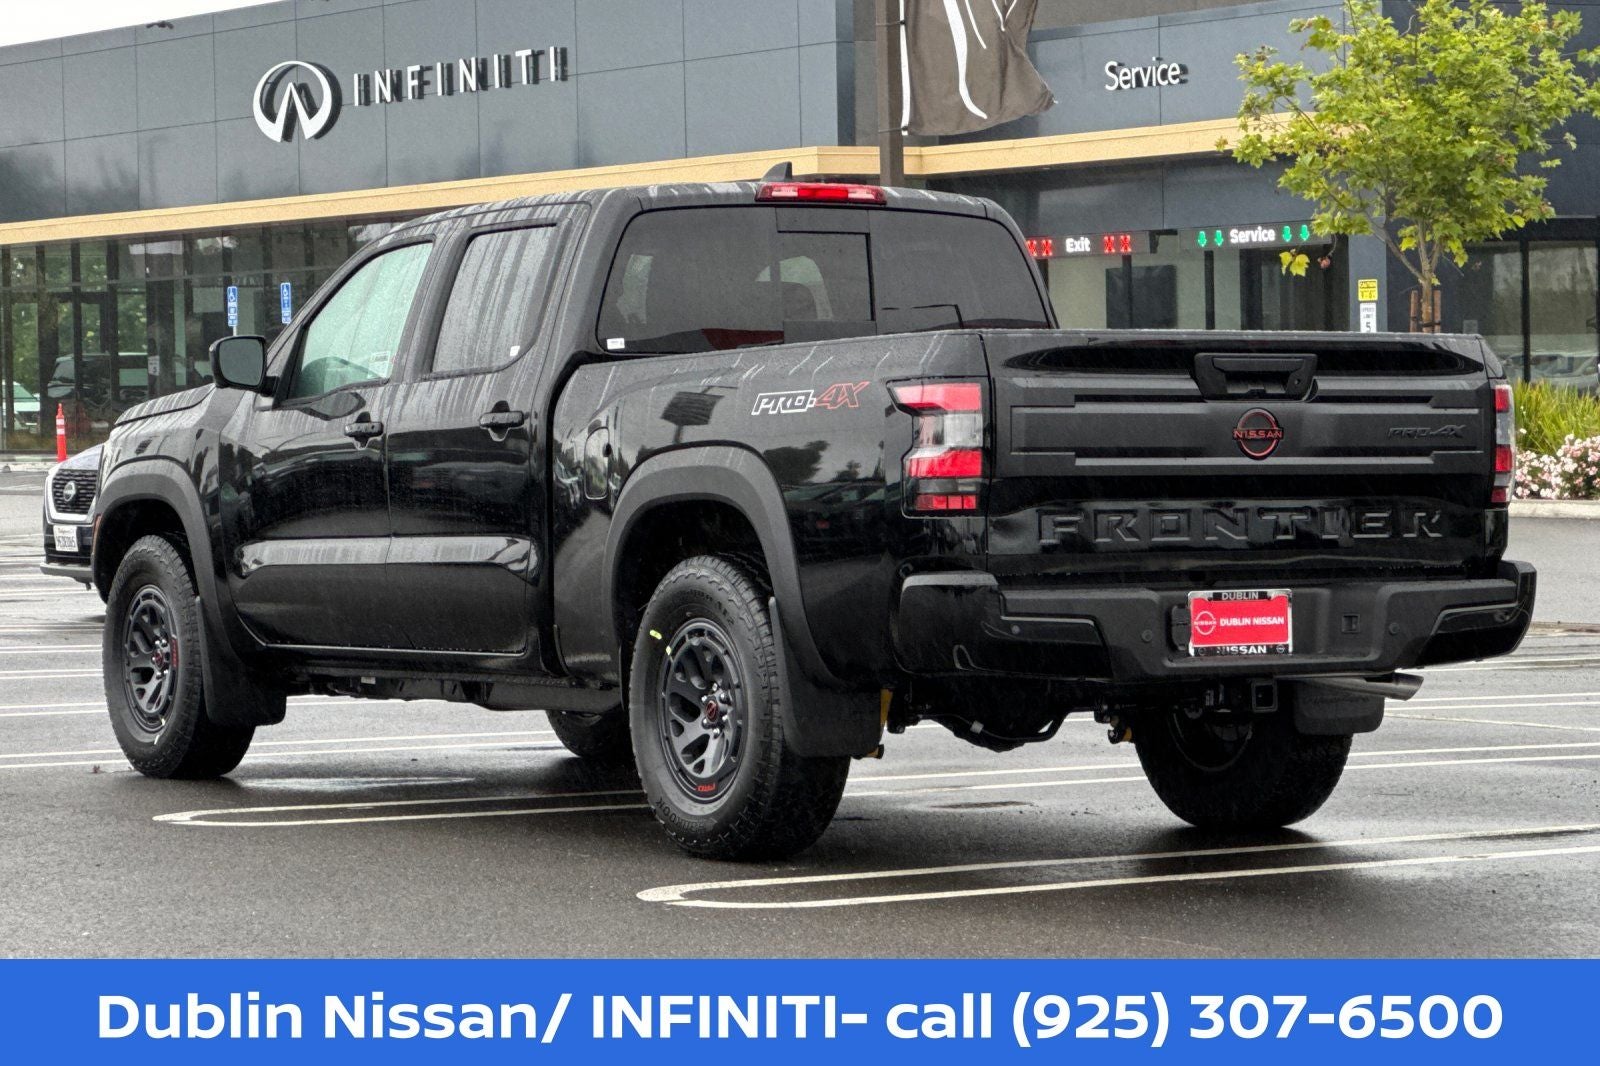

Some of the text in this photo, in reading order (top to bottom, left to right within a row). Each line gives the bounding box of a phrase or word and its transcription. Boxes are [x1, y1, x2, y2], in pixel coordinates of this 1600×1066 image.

[353, 46, 564, 107] INFINITI
[1104, 57, 1183, 91] Service
[1229, 226, 1276, 245] Service
[1065, 237, 1091, 253] Exit
[1233, 429, 1283, 439] NISSAN
[1036, 506, 1443, 546] FRONTIER
[1221, 592, 1259, 600] DUBLIN
[1220, 617, 1284, 626] DUBLIN NISSAN
